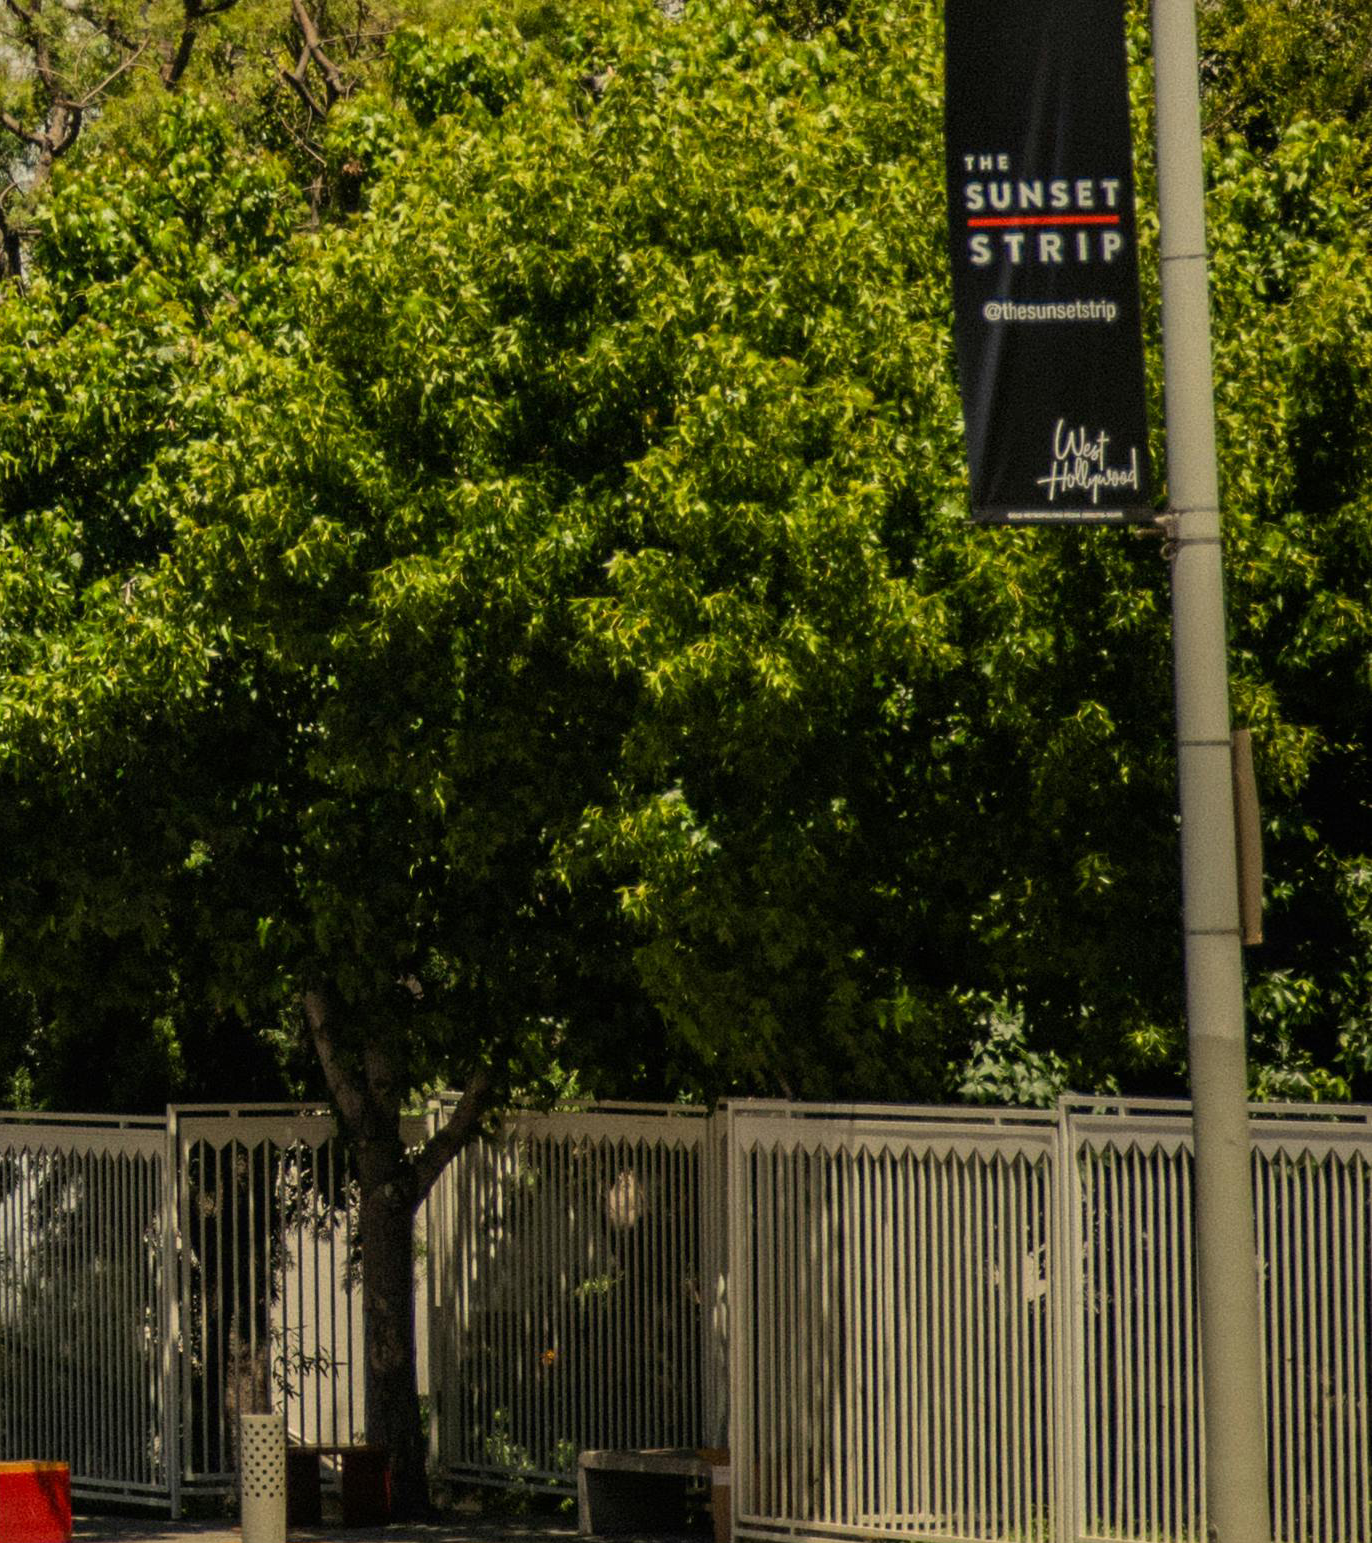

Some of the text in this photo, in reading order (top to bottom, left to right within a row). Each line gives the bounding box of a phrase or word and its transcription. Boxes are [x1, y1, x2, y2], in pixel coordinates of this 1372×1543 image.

[964, 155, 1009, 171] THE
[966, 179, 1119, 209] SUNSET
[970, 232, 1122, 264] STRIP
[983, 301, 1116, 322] @thesunsetstrip
[1055, 418, 1109, 471] West
[1037, 447, 1137, 504] Hollywood
